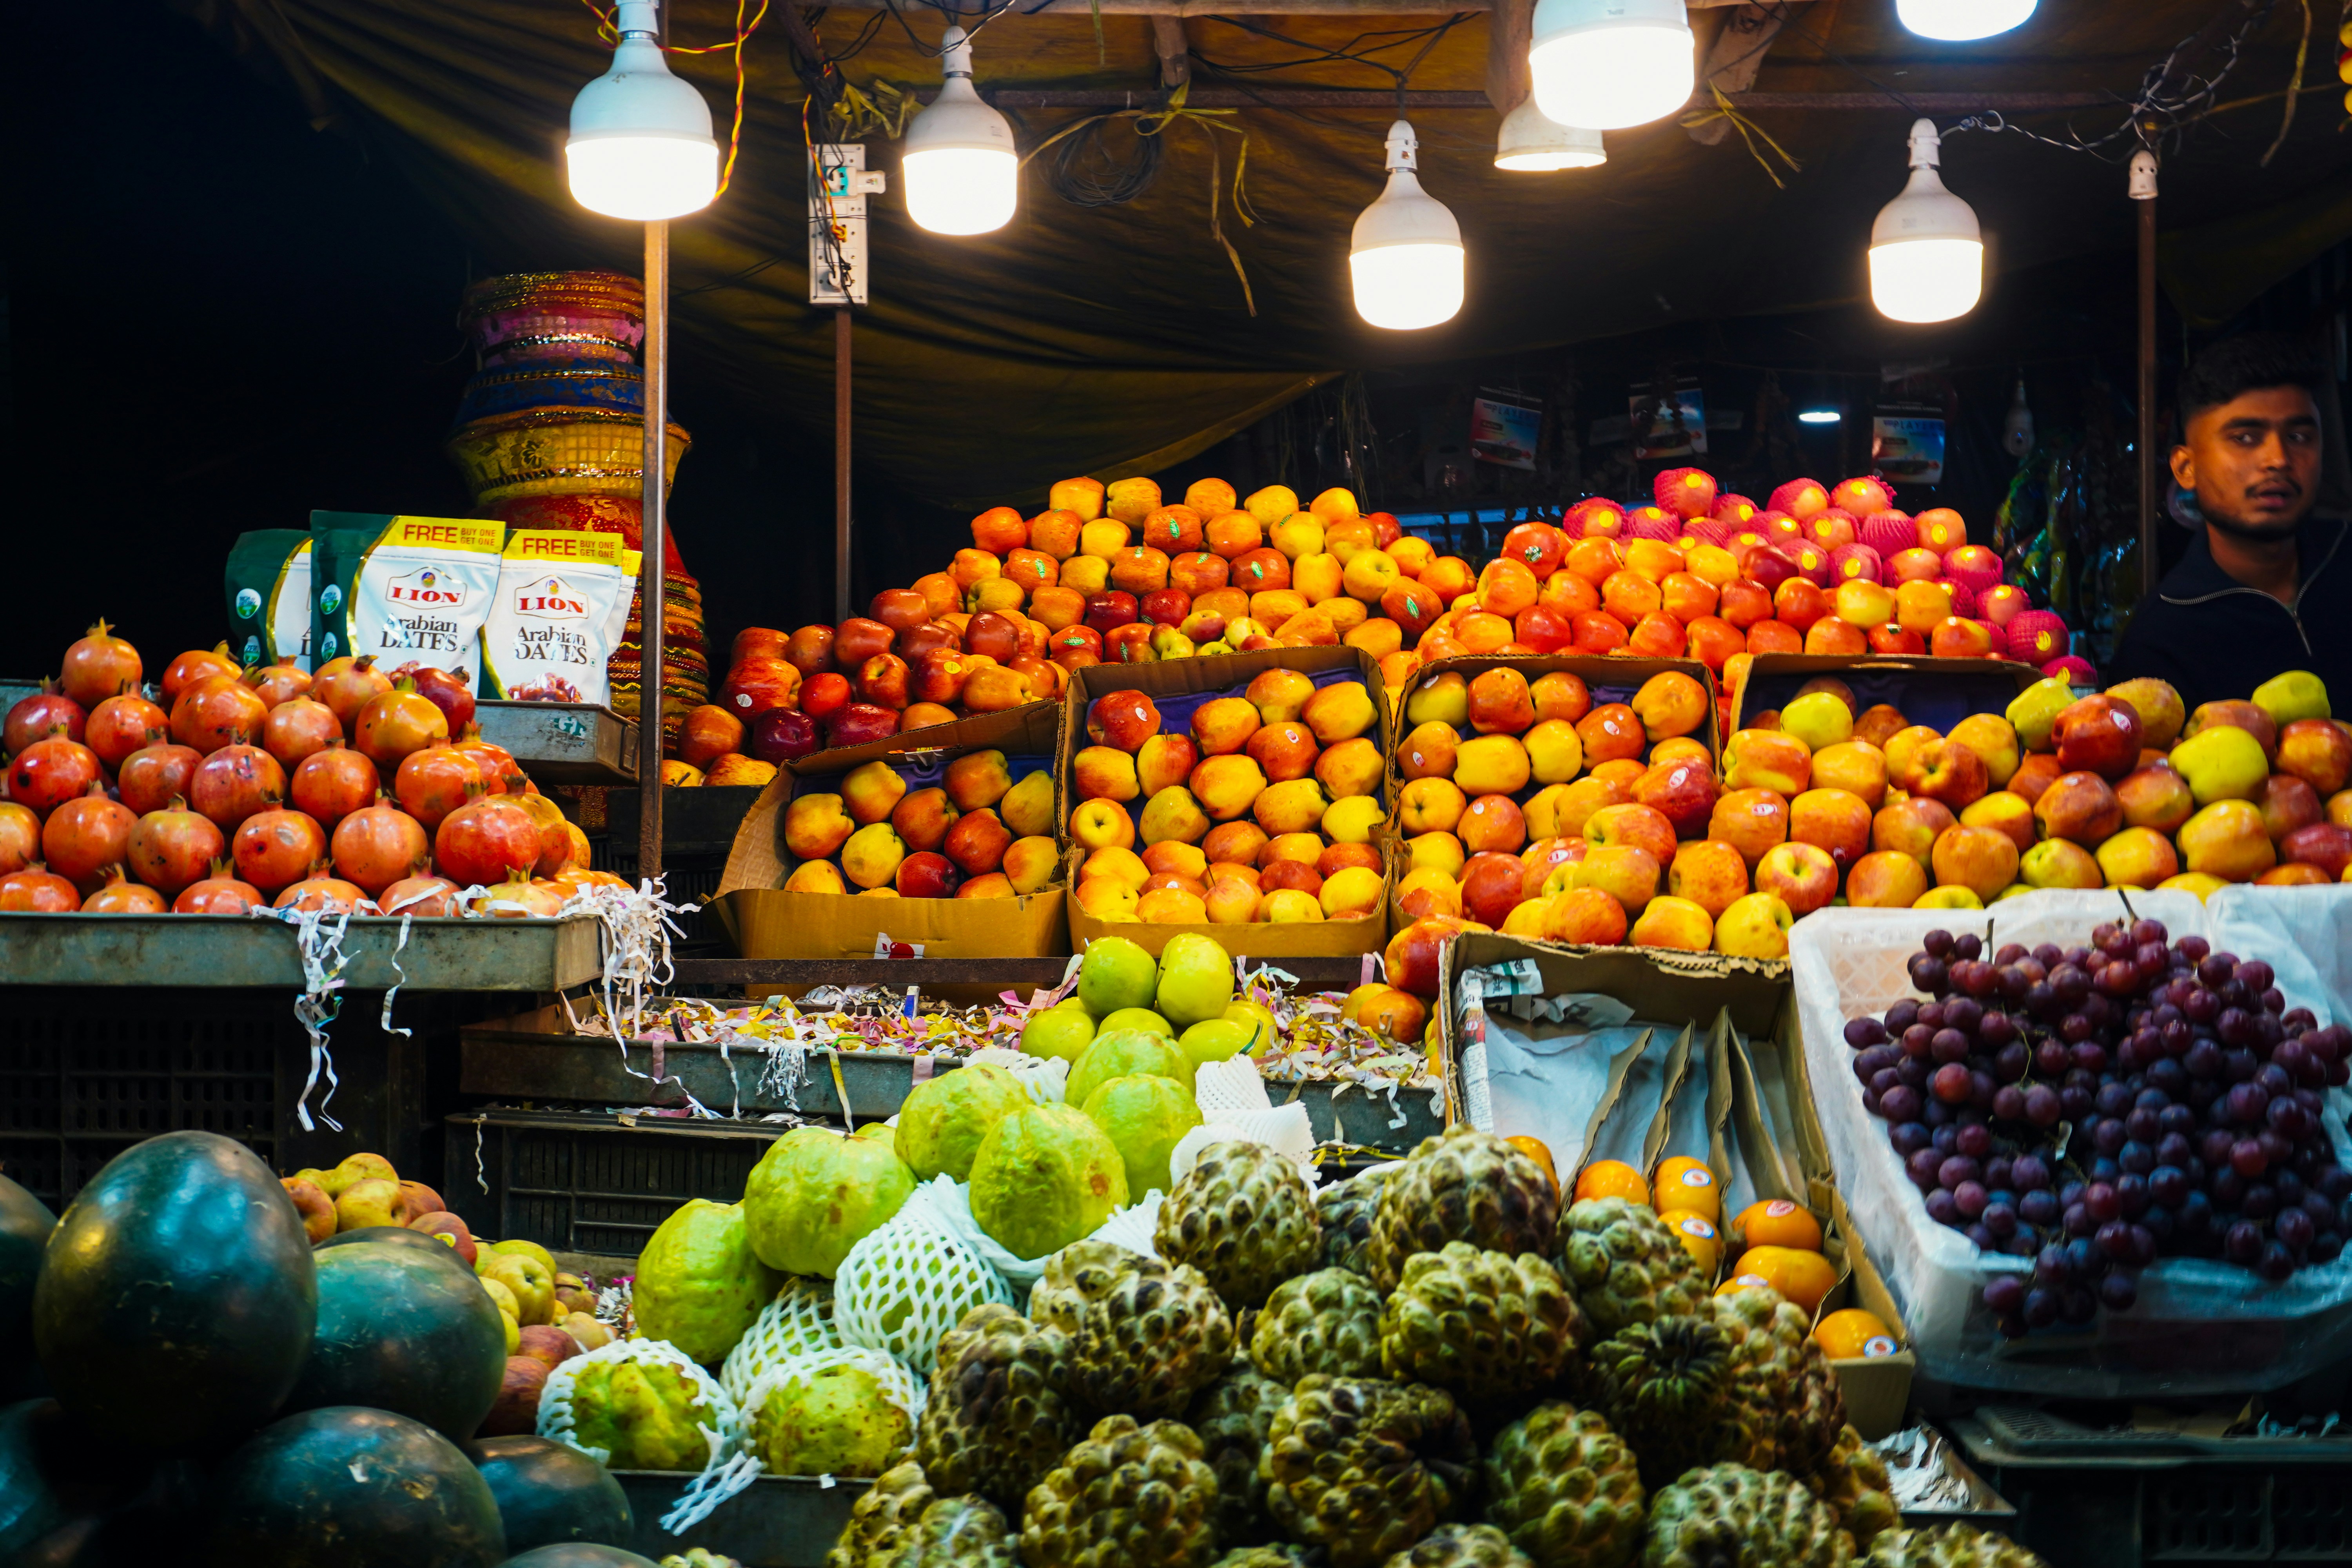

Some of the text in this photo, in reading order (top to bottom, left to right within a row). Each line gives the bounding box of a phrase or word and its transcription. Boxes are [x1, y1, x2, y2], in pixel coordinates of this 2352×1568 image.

[404, 524, 458, 543] FREE
[461, 528, 495, 537] BUY ONE
[479, 537, 495, 546] ONE
[523, 538, 576, 556] FREE
[599, 541, 615, 549] ONE
[392, 586, 462, 603] LION
[519, 597, 584, 613] LION
[383, 613, 458, 633] Arabian
[380, 631, 458, 652] DATES
[518, 626, 586, 646] Arabian
